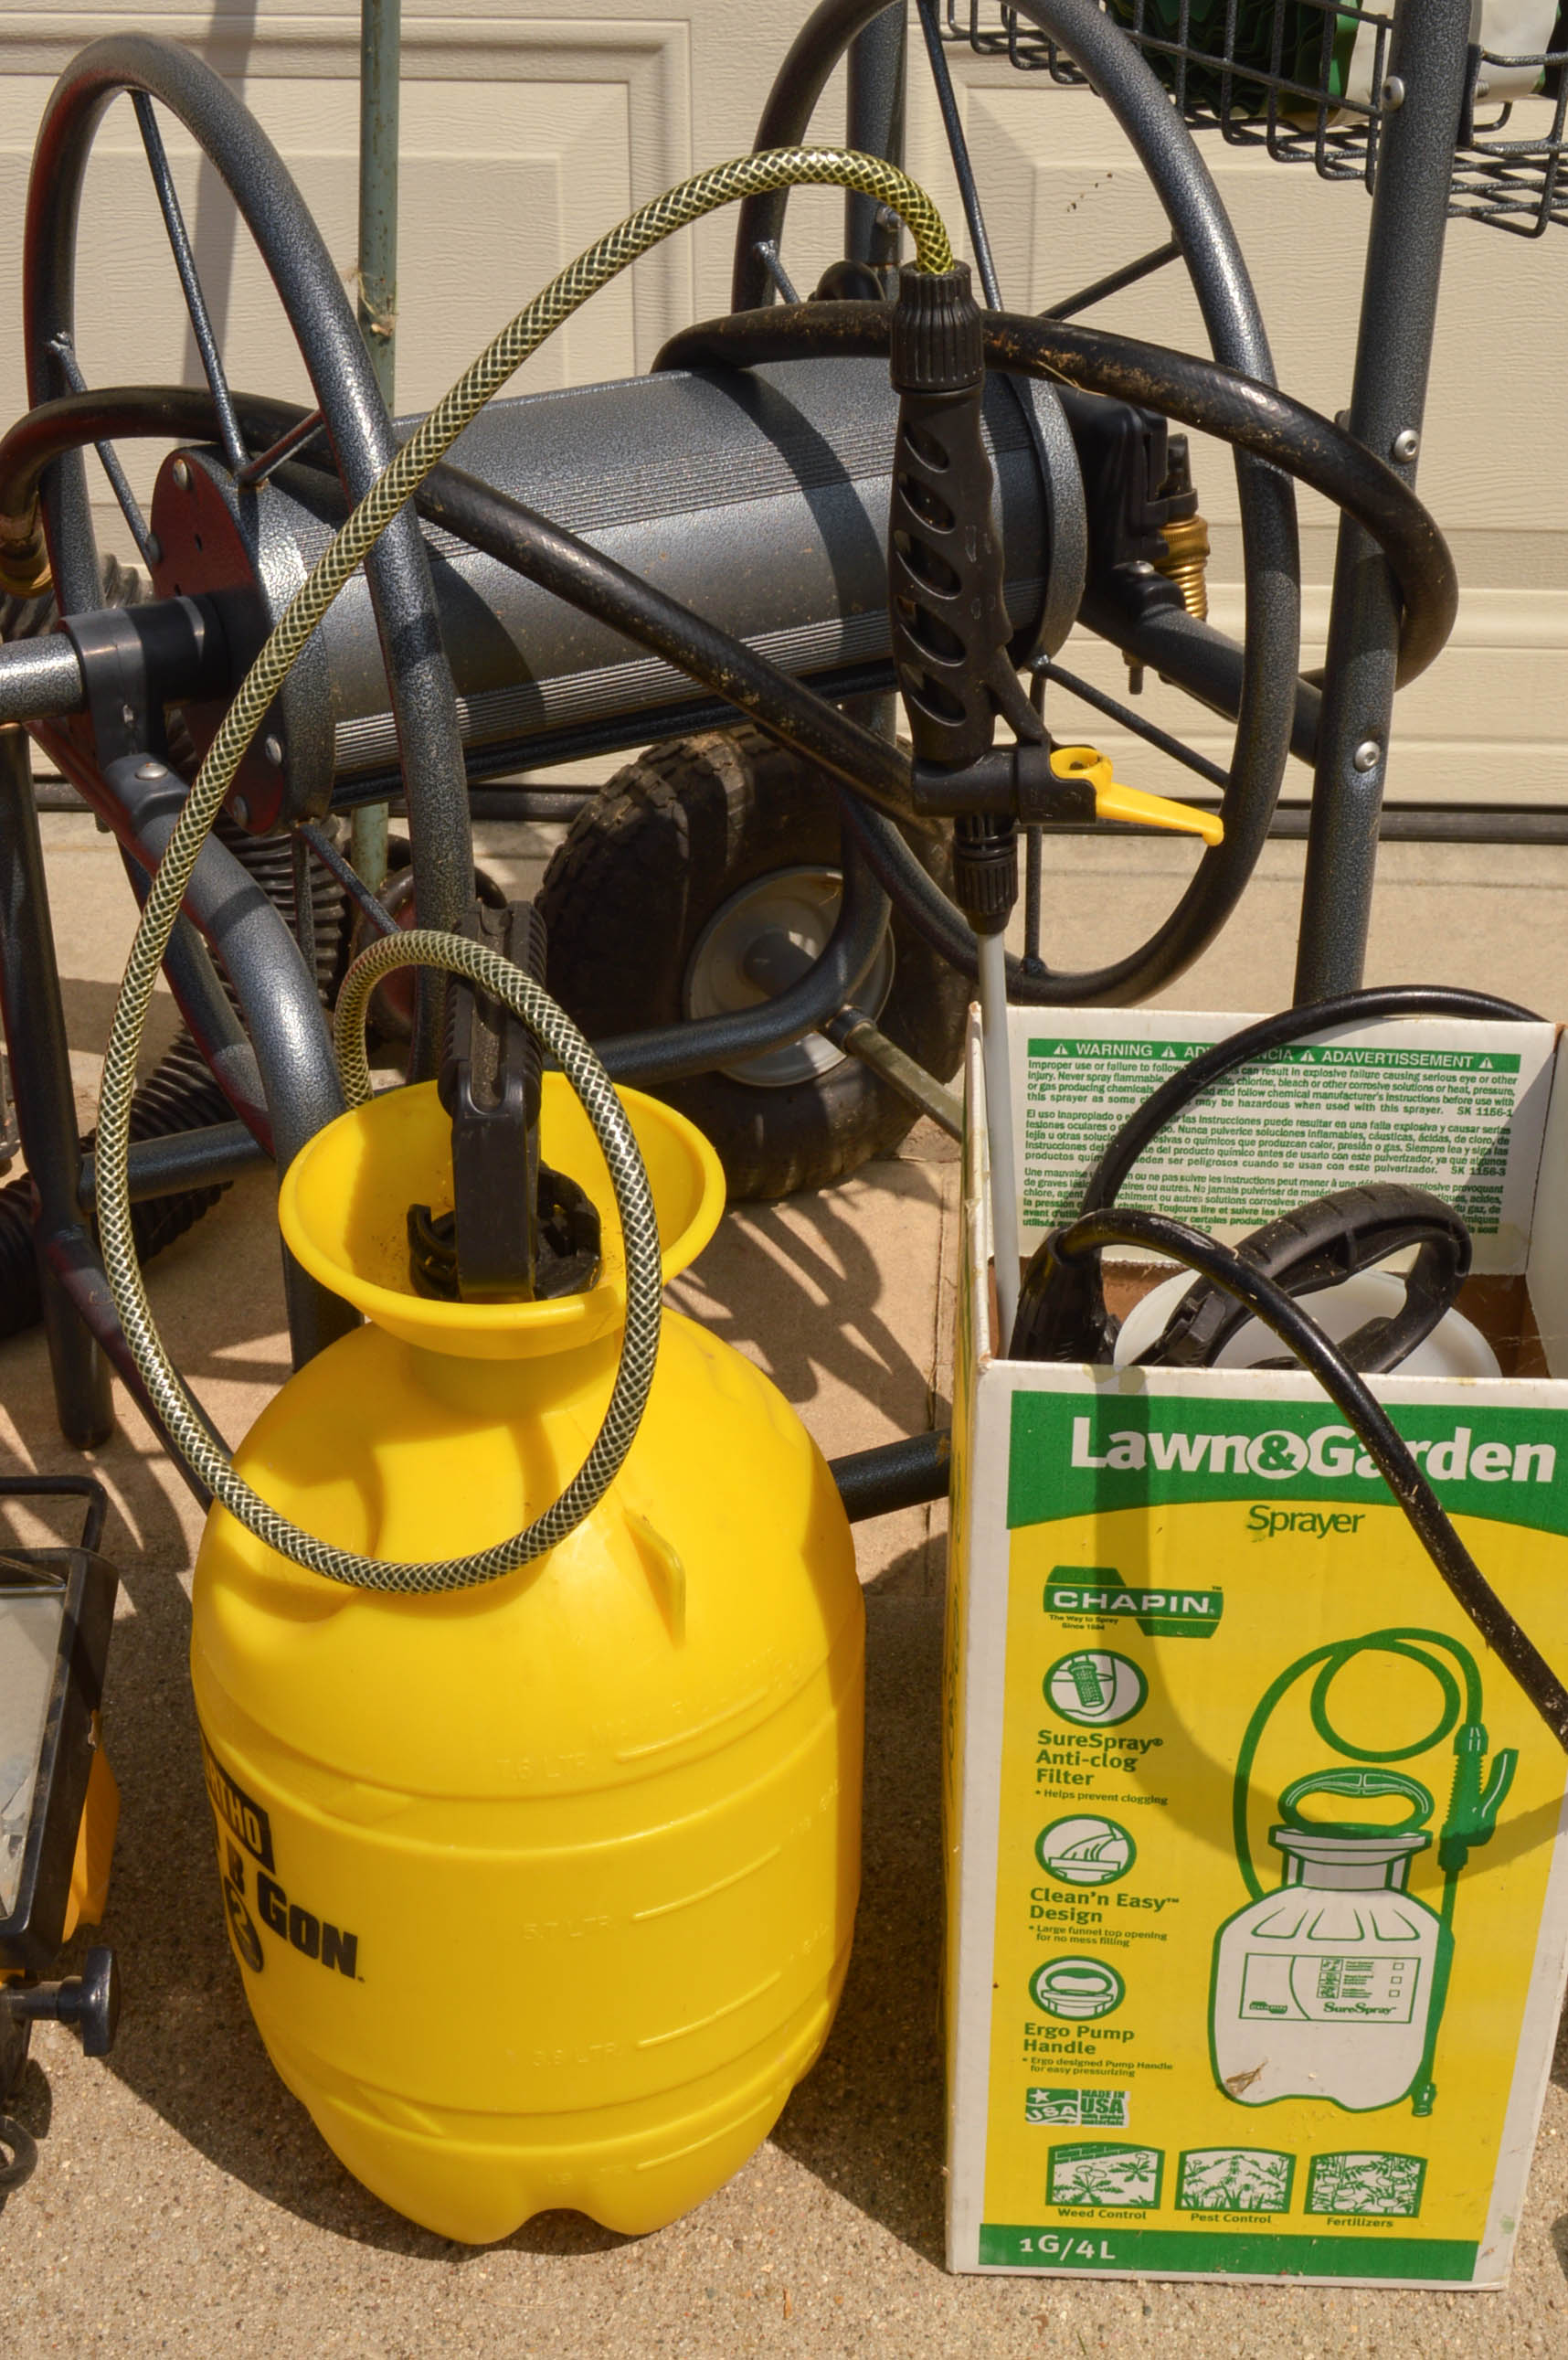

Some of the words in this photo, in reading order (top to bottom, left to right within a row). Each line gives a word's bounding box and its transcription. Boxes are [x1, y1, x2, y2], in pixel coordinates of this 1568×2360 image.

[1076, 1043, 1152, 1056] WARNING
[1322, 1051, 1473, 1068] ADAVERTISSEMENT
[1028, 1060, 1072, 1070] Improper
[1107, 1062, 1138, 1071] failure
[1262, 1068, 1288, 1076] result
[1303, 1068, 1347, 1078] explosive
[1350, 1069, 1380, 1079] failure
[1383, 1071, 1420, 1082] causing
[1423, 1073, 1457, 1082] serious
[1491, 1077, 1518, 1085] other
[1058, 1072, 1084, 1080] Never
[1086, 1074, 1111, 1083] spray
[1236, 1077, 1276, 1087] chlorine,
[1279, 1079, 1308, 1087] bleach
[1323, 1080, 1346, 1089] other
[1349, 1081, 1390, 1090] corrosive
[1393, 1082, 1434, 1092] solutions
[1447, 1085, 1470, 1095] heat,
[1473, 1087, 1515, 1096] pressure,
[1059, 1083, 1105, 1093] producing
[1237, 1089, 1266, 1097] follow
[1267, 1090, 1309, 1098] chemical
[1312, 1091, 1383, 1101] manufacturer's
[1386, 1092, 1440, 1103] instructions
[1443, 1094, 1472, 1104] before
[1494, 1097, 1514, 1106] with
[1027, 1092, 1045, 1100] this
[1050, 1094, 1086, 1103] sprayer
[1238, 1100, 1290, 1109] hazardous
[1295, 1101, 1320, 1110] when
[1326, 1102, 1349, 1111] used
[1354, 1102, 1375, 1111] with
[1381, 1103, 1398, 1112] this
[1404, 1105, 1443, 1115] sprayer.
[1477, 1108, 1513, 1117] 1156-1
[1246, 1504, 1365, 1538] Sprayer
[1036, 1749, 1138, 1772] Anti-clog
[1036, 1769, 1094, 1785] Filter
[1044, 1790, 1075, 1800] Helps
[1077, 1792, 1118, 1802] prevent
[1121, 1794, 1168, 1806] clogging
[1031, 1905, 1102, 1924] Design
[1037, 1925, 1065, 1934] Large
[1068, 1927, 1101, 1936] funnel
[1105, 1929, 1121, 1938] top
[1125, 1930, 1167, 1940] opening
[1037, 1933, 1050, 1941] for
[1070, 1936, 1097, 1944] mess
[1100, 1938, 1129, 1947] filling
[1024, 2023, 1070, 2038] Ergo
[1077, 2025, 1135, 2042] Pump
[1023, 2039, 1096, 2054] Handle
[1031, 2057, 1053, 2066] Ergo
[1056, 2058, 1102, 2068] designed
[1106, 2060, 1134, 2069] Pump
[1137, 2061, 1172, 2069] Handle
[1047, 2067, 1070, 2075] easy
[1073, 2068, 1135, 2078] pressurizing
[1026, 2106, 1076, 2121] USA
[1081, 2099, 1123, 2113] USA
[1058, 2208, 1094, 2217] Weed
[1098, 2209, 1146, 2219] Control
[1191, 2213, 1218, 2222] Pest
[1224, 2214, 1271, 2224] Control
[1327, 2217, 1393, 2227] Fertilizers
